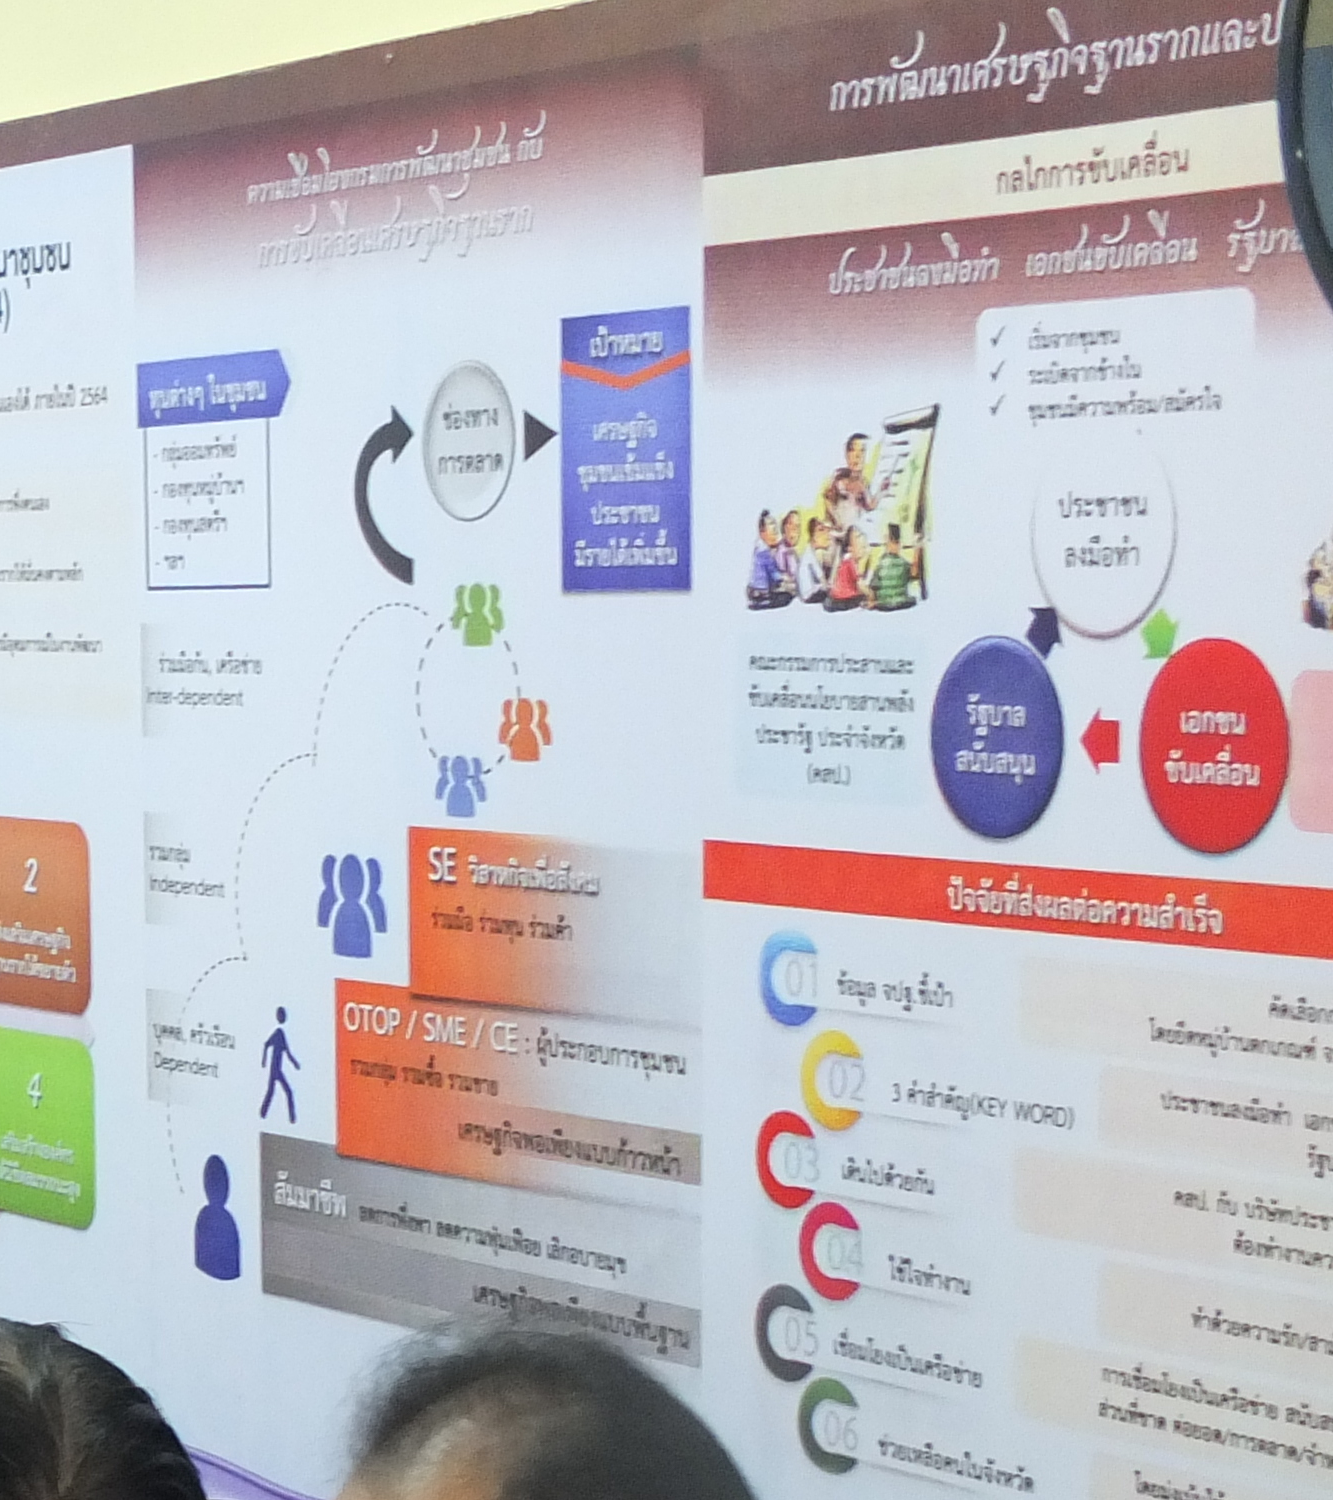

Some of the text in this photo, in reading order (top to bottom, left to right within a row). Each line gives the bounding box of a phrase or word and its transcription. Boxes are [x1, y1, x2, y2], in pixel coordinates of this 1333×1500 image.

[996, 130, 1190, 195] กลไกการขับเคลื่อน
[1179, 709, 1246, 736] เอกชน
[23, 857, 39, 893] 2
[427, 845, 458, 883] SE
[946, 872, 1225, 935] ปัจจัยที่ส่งผลต่อความสำเร็จ
[343, 1001, 402, 1037] OTOP
[423, 1011, 467, 1047] SME
[490, 1020, 519, 1054] CE
[26, 1072, 44, 1109] 4
